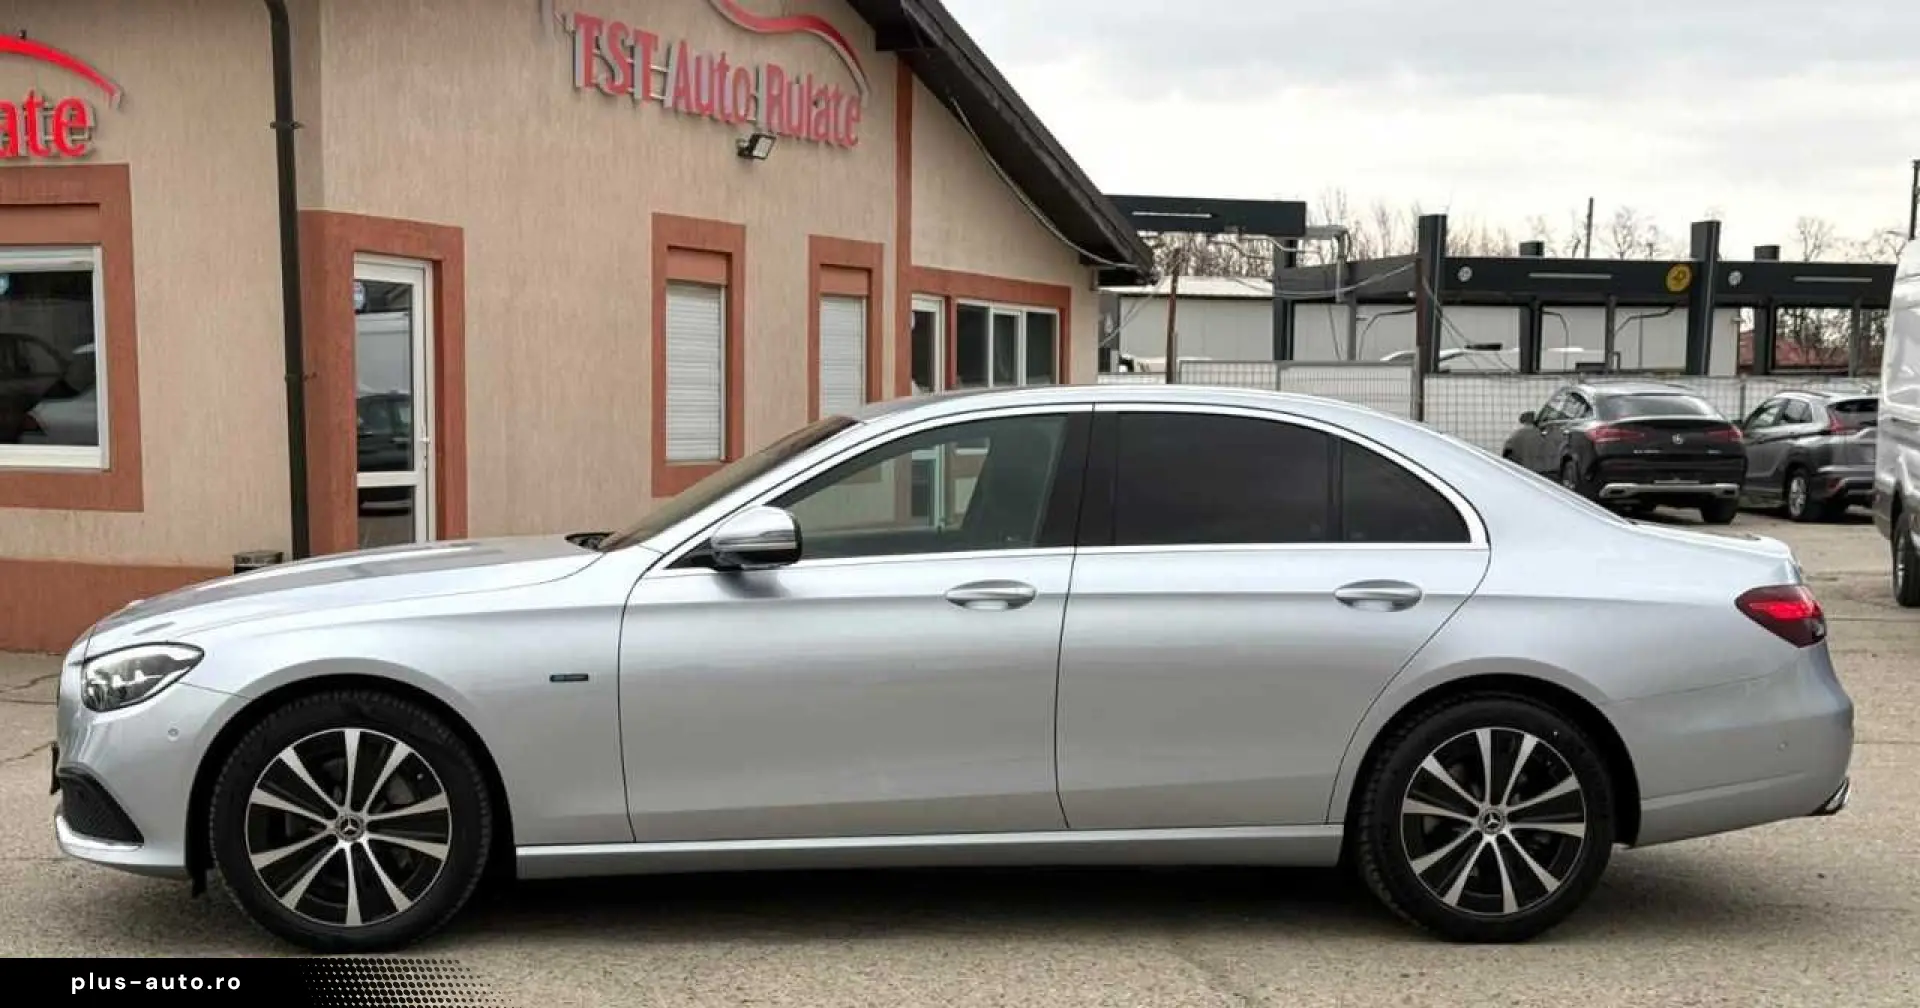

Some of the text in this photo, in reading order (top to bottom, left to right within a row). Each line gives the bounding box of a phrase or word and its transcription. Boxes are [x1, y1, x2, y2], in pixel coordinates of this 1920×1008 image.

[573, 12, 861, 148] TST Auto Rulate
